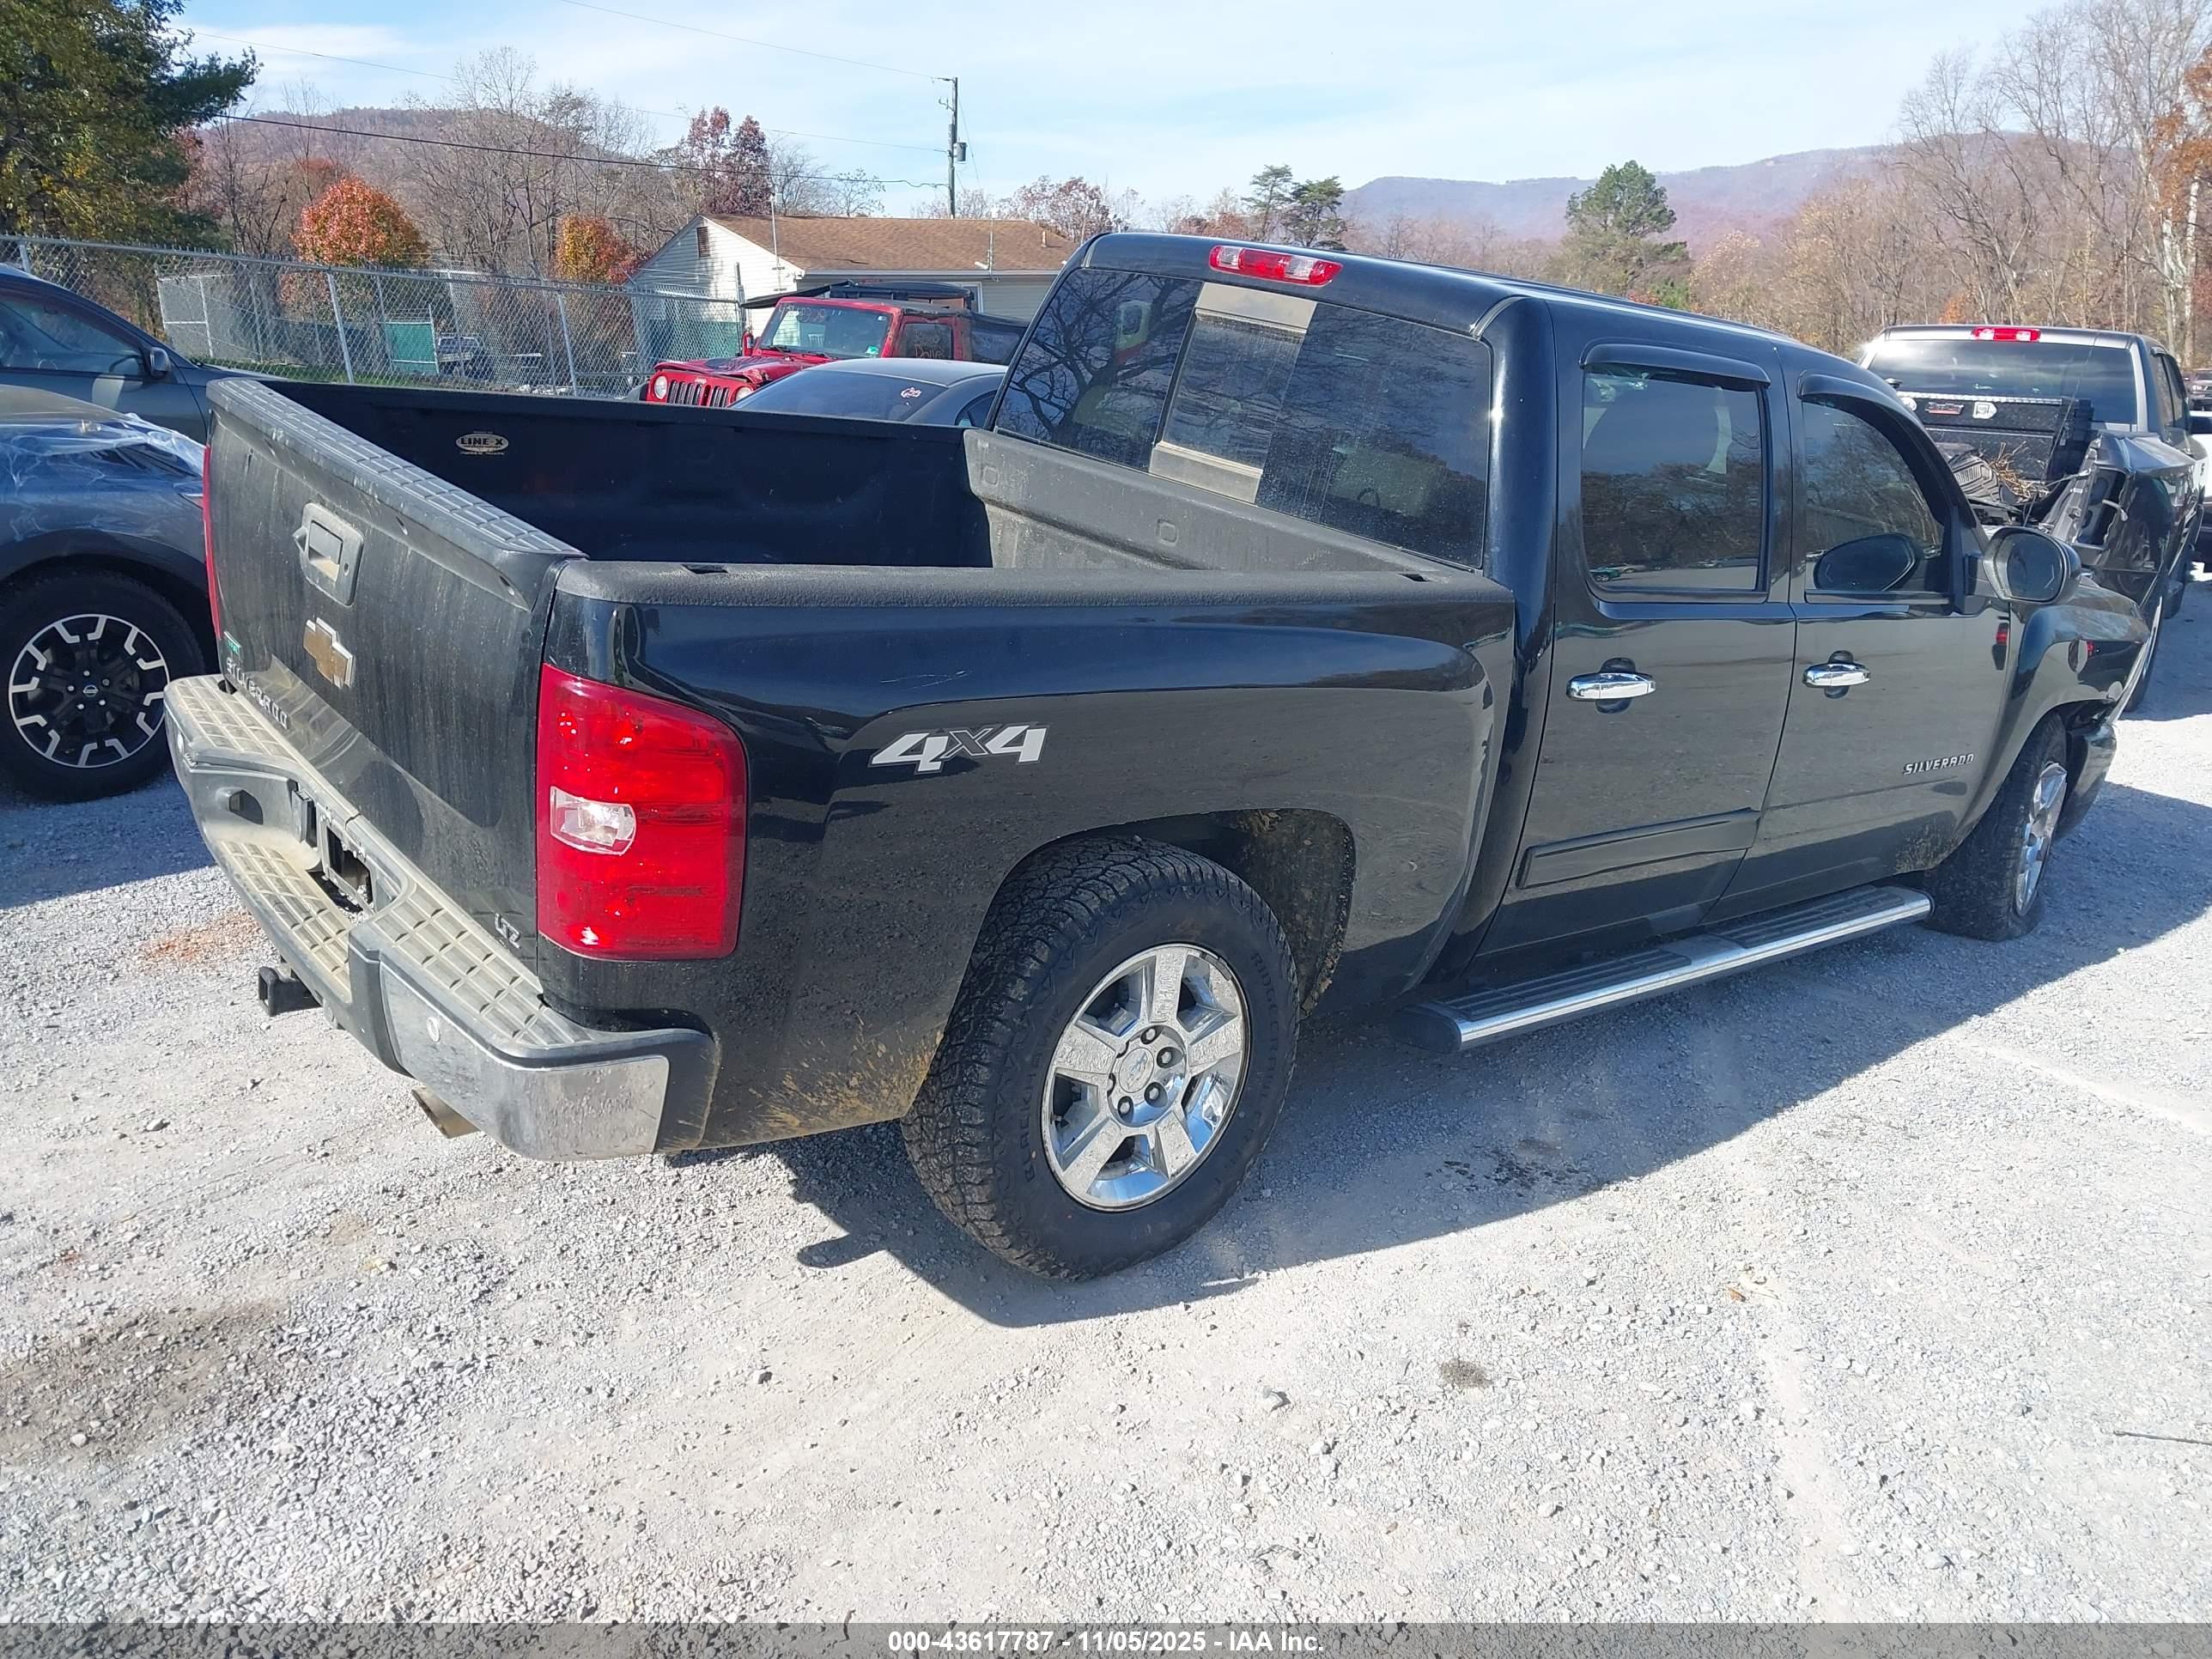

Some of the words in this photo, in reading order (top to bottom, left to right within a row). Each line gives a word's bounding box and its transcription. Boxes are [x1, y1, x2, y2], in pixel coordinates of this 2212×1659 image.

[460, 437, 503, 446] LINE-X
[226, 657, 288, 729] SILVERADO
[1903, 753, 1974, 775] SILVERADO
[495, 913, 520, 948] LTZ
